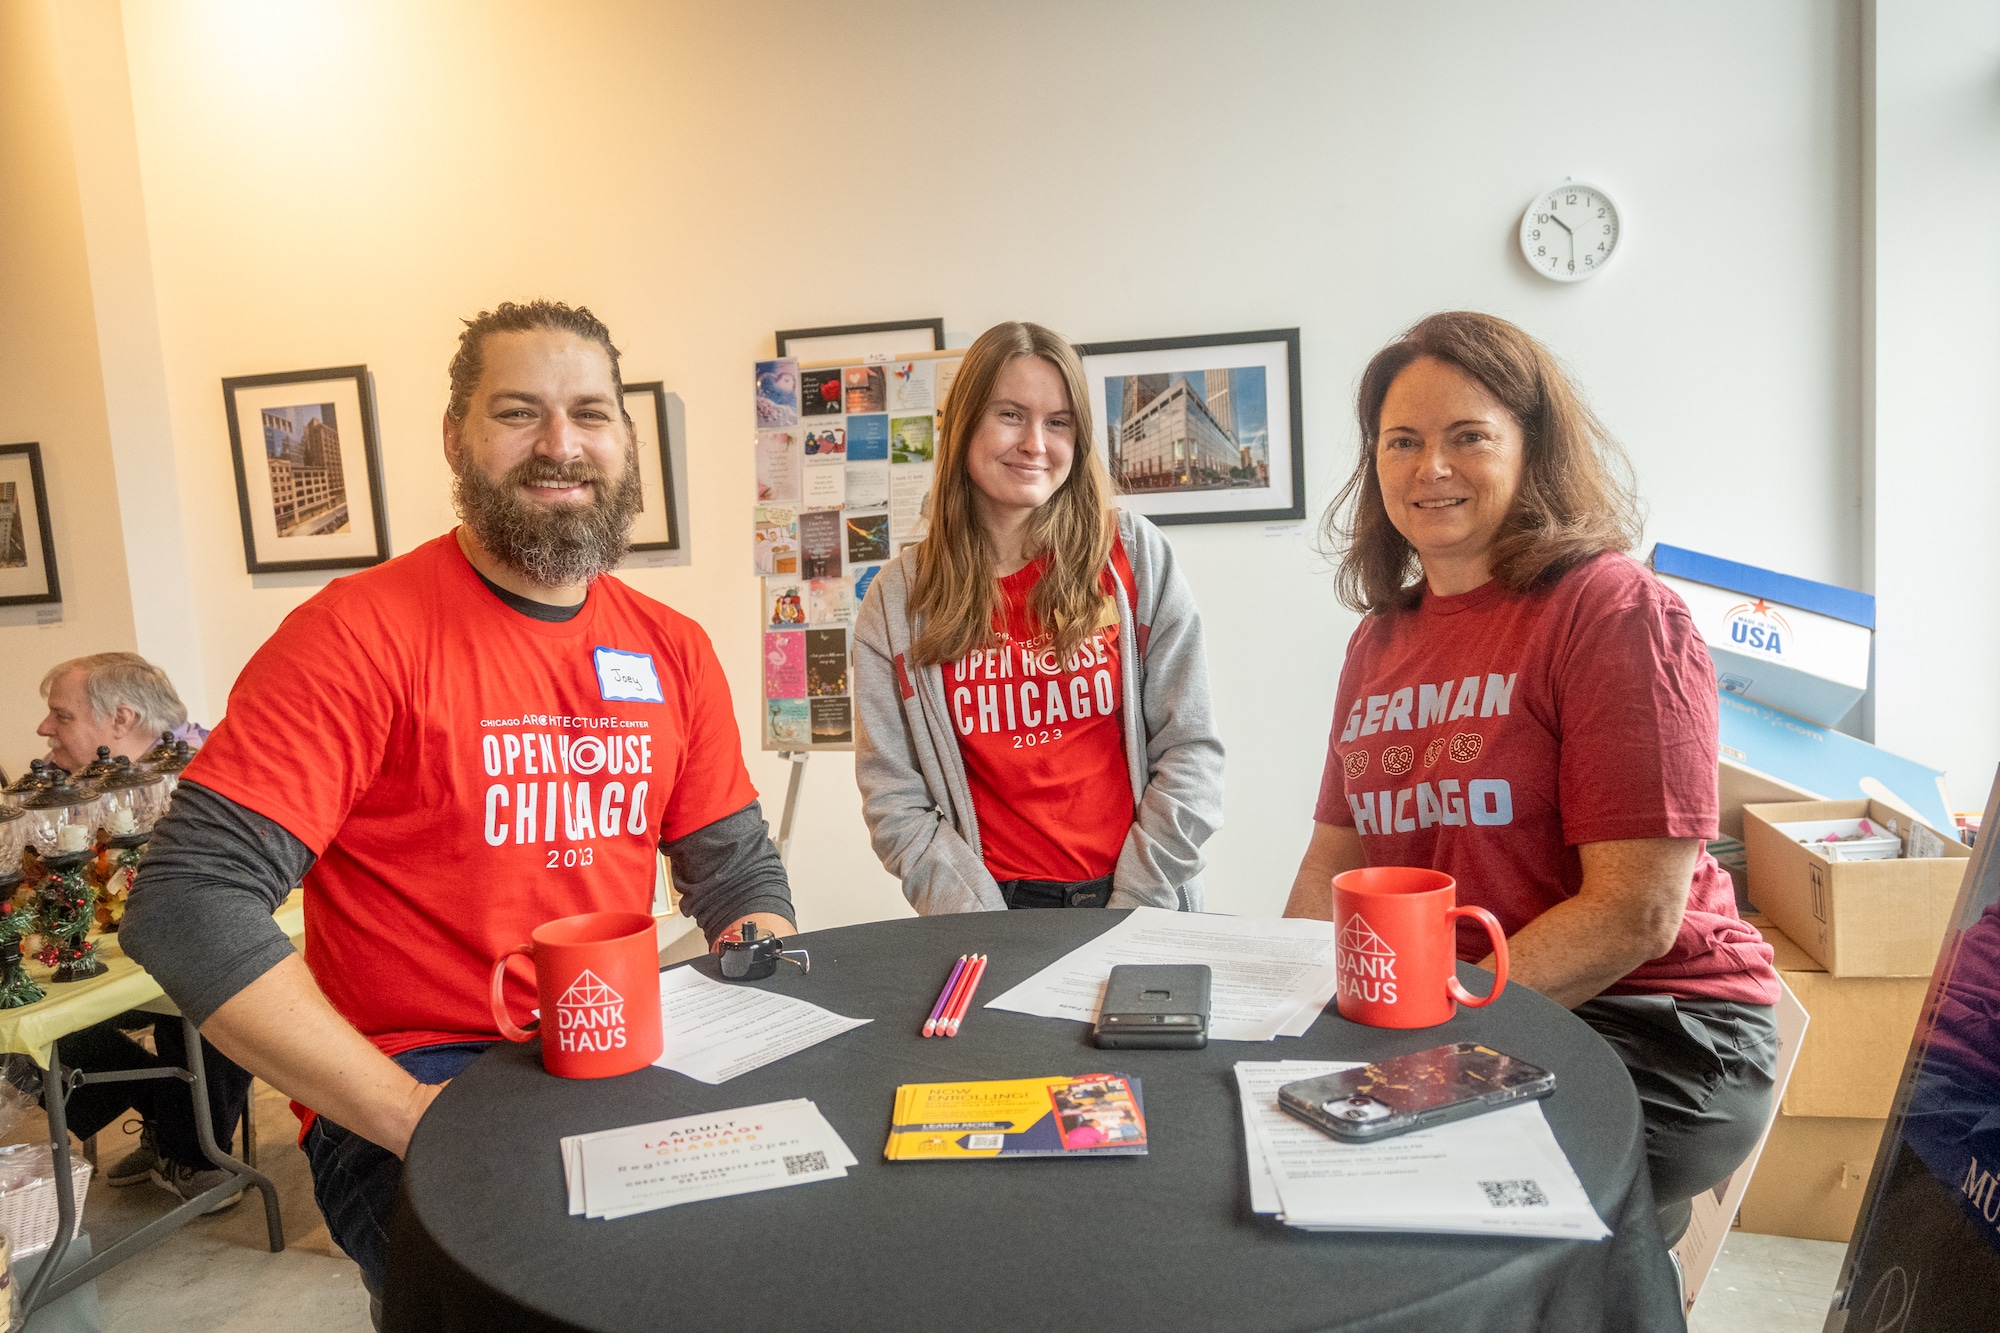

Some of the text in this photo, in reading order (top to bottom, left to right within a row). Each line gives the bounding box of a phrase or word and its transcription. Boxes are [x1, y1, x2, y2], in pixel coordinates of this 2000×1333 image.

[1551, 199, 1557, 210] 11
[1566, 194, 1578, 205] 12
[1537, 213, 1549, 224] 10
[1597, 207, 1606, 218] 2
[1532, 229, 1541, 240] 9
[1602, 224, 1611, 235] 3
[1537, 246, 1546, 256] 8
[1597, 242, 1605, 252] 4
[1550, 257, 1558, 268] 7
[1567, 260, 1575, 271] 6
[1585, 254, 1593, 265] 5
[1731, 621, 1782, 654] USA
[954, 645, 1013, 682] OPEN
[611, 668, 643, 691] Joey
[953, 669, 1114, 736] CHICAGO
[1340, 672, 1517, 743] GERMAN
[480, 718, 520, 728] CHICAGO
[620, 720, 649, 728] CENTER
[1012, 728, 1063, 749] 2023
[482, 732, 652, 777] OPEN HOUSE
[484, 780, 649, 847] CHICAGO
[1348, 778, 1514, 836] HICAGO
[1337, 947, 1397, 980] DANK
[1337, 970, 1398, 1005] HAUS
[556, 1003, 625, 1030] DANK
[558, 1027, 627, 1053] HAUS
[644, 1124, 764, 1149] LANGUAGE
[669, 1121, 736, 1137] ADULT
[618, 1138, 800, 1173] Registration Open
[656, 1134, 757, 1155] CLASSES
[625, 1177, 666, 1188] CHECK
[700, 1163, 749, 1175] WEBSITE
